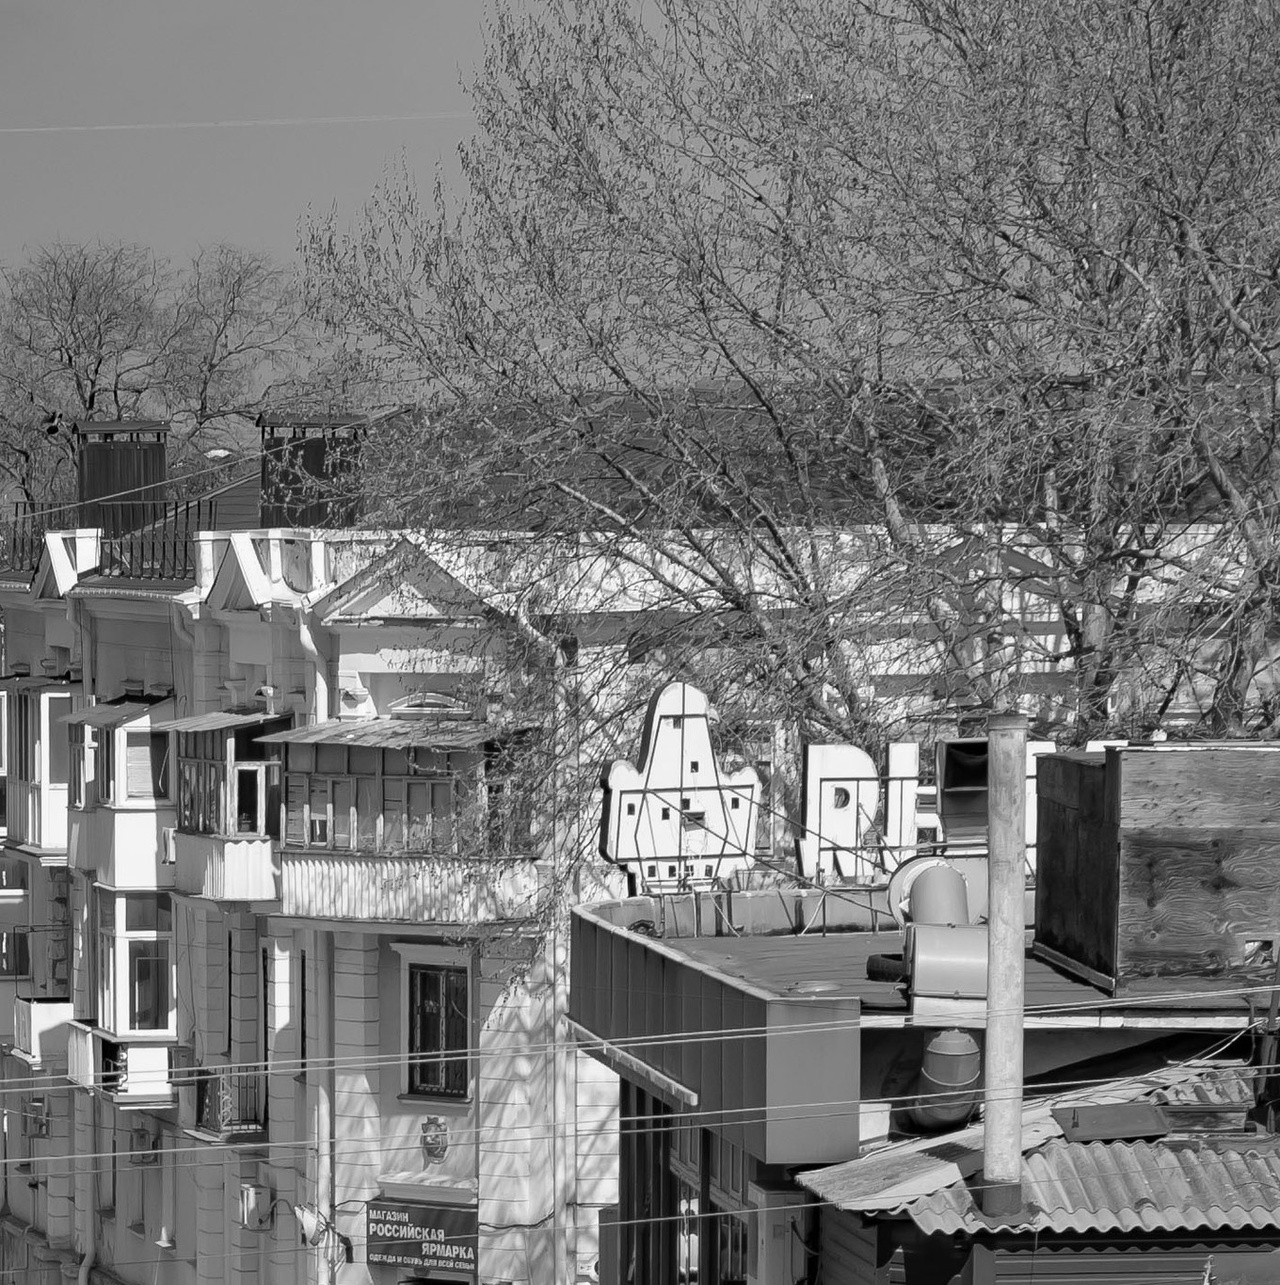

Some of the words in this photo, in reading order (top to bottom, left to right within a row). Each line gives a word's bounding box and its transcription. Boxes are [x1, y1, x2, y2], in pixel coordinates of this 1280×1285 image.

[369, 1209, 409, 1222] МАГАЗИН
[369, 1223, 445, 1242] РОССИЙСКАЯ
[421, 1242, 475, 1260] ЯРМАРКА
[369, 1253, 397, 1263] ОДЕЖДА
[403, 1256, 423, 1265] ОБУВЬ
[424, 1258, 438, 1267] ДЛЯ
[438, 1259, 454, 1268] ВСЕЙ
[454, 1261, 475, 1270] СЕМЬИ
